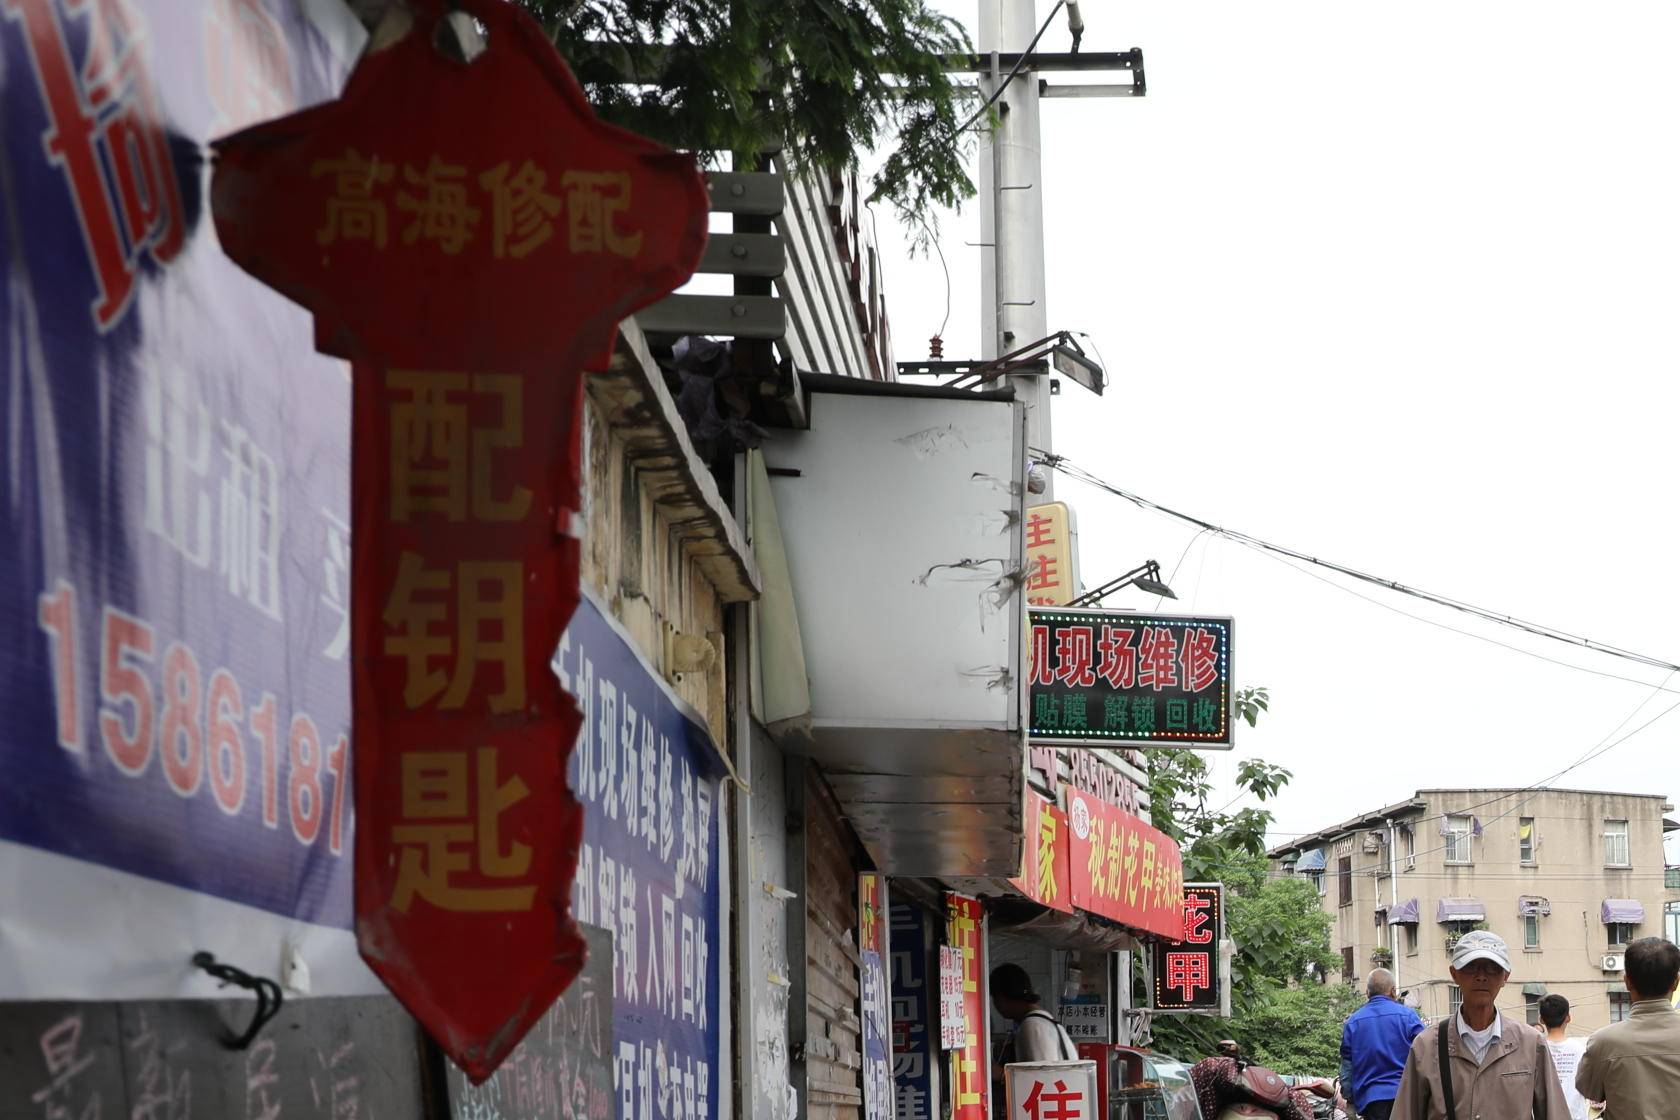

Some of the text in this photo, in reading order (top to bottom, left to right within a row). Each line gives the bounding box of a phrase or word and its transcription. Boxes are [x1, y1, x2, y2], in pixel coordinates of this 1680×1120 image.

[312, 148, 644, 258] 高海修配
[384, 370, 538, 912] 配钥匙
[1035, 693, 1217, 733] 贴膜 解锁 回收
[1088, 815, 1155, 912] 秘制花甲
[1167, 894, 1212, 1001] 花甲
